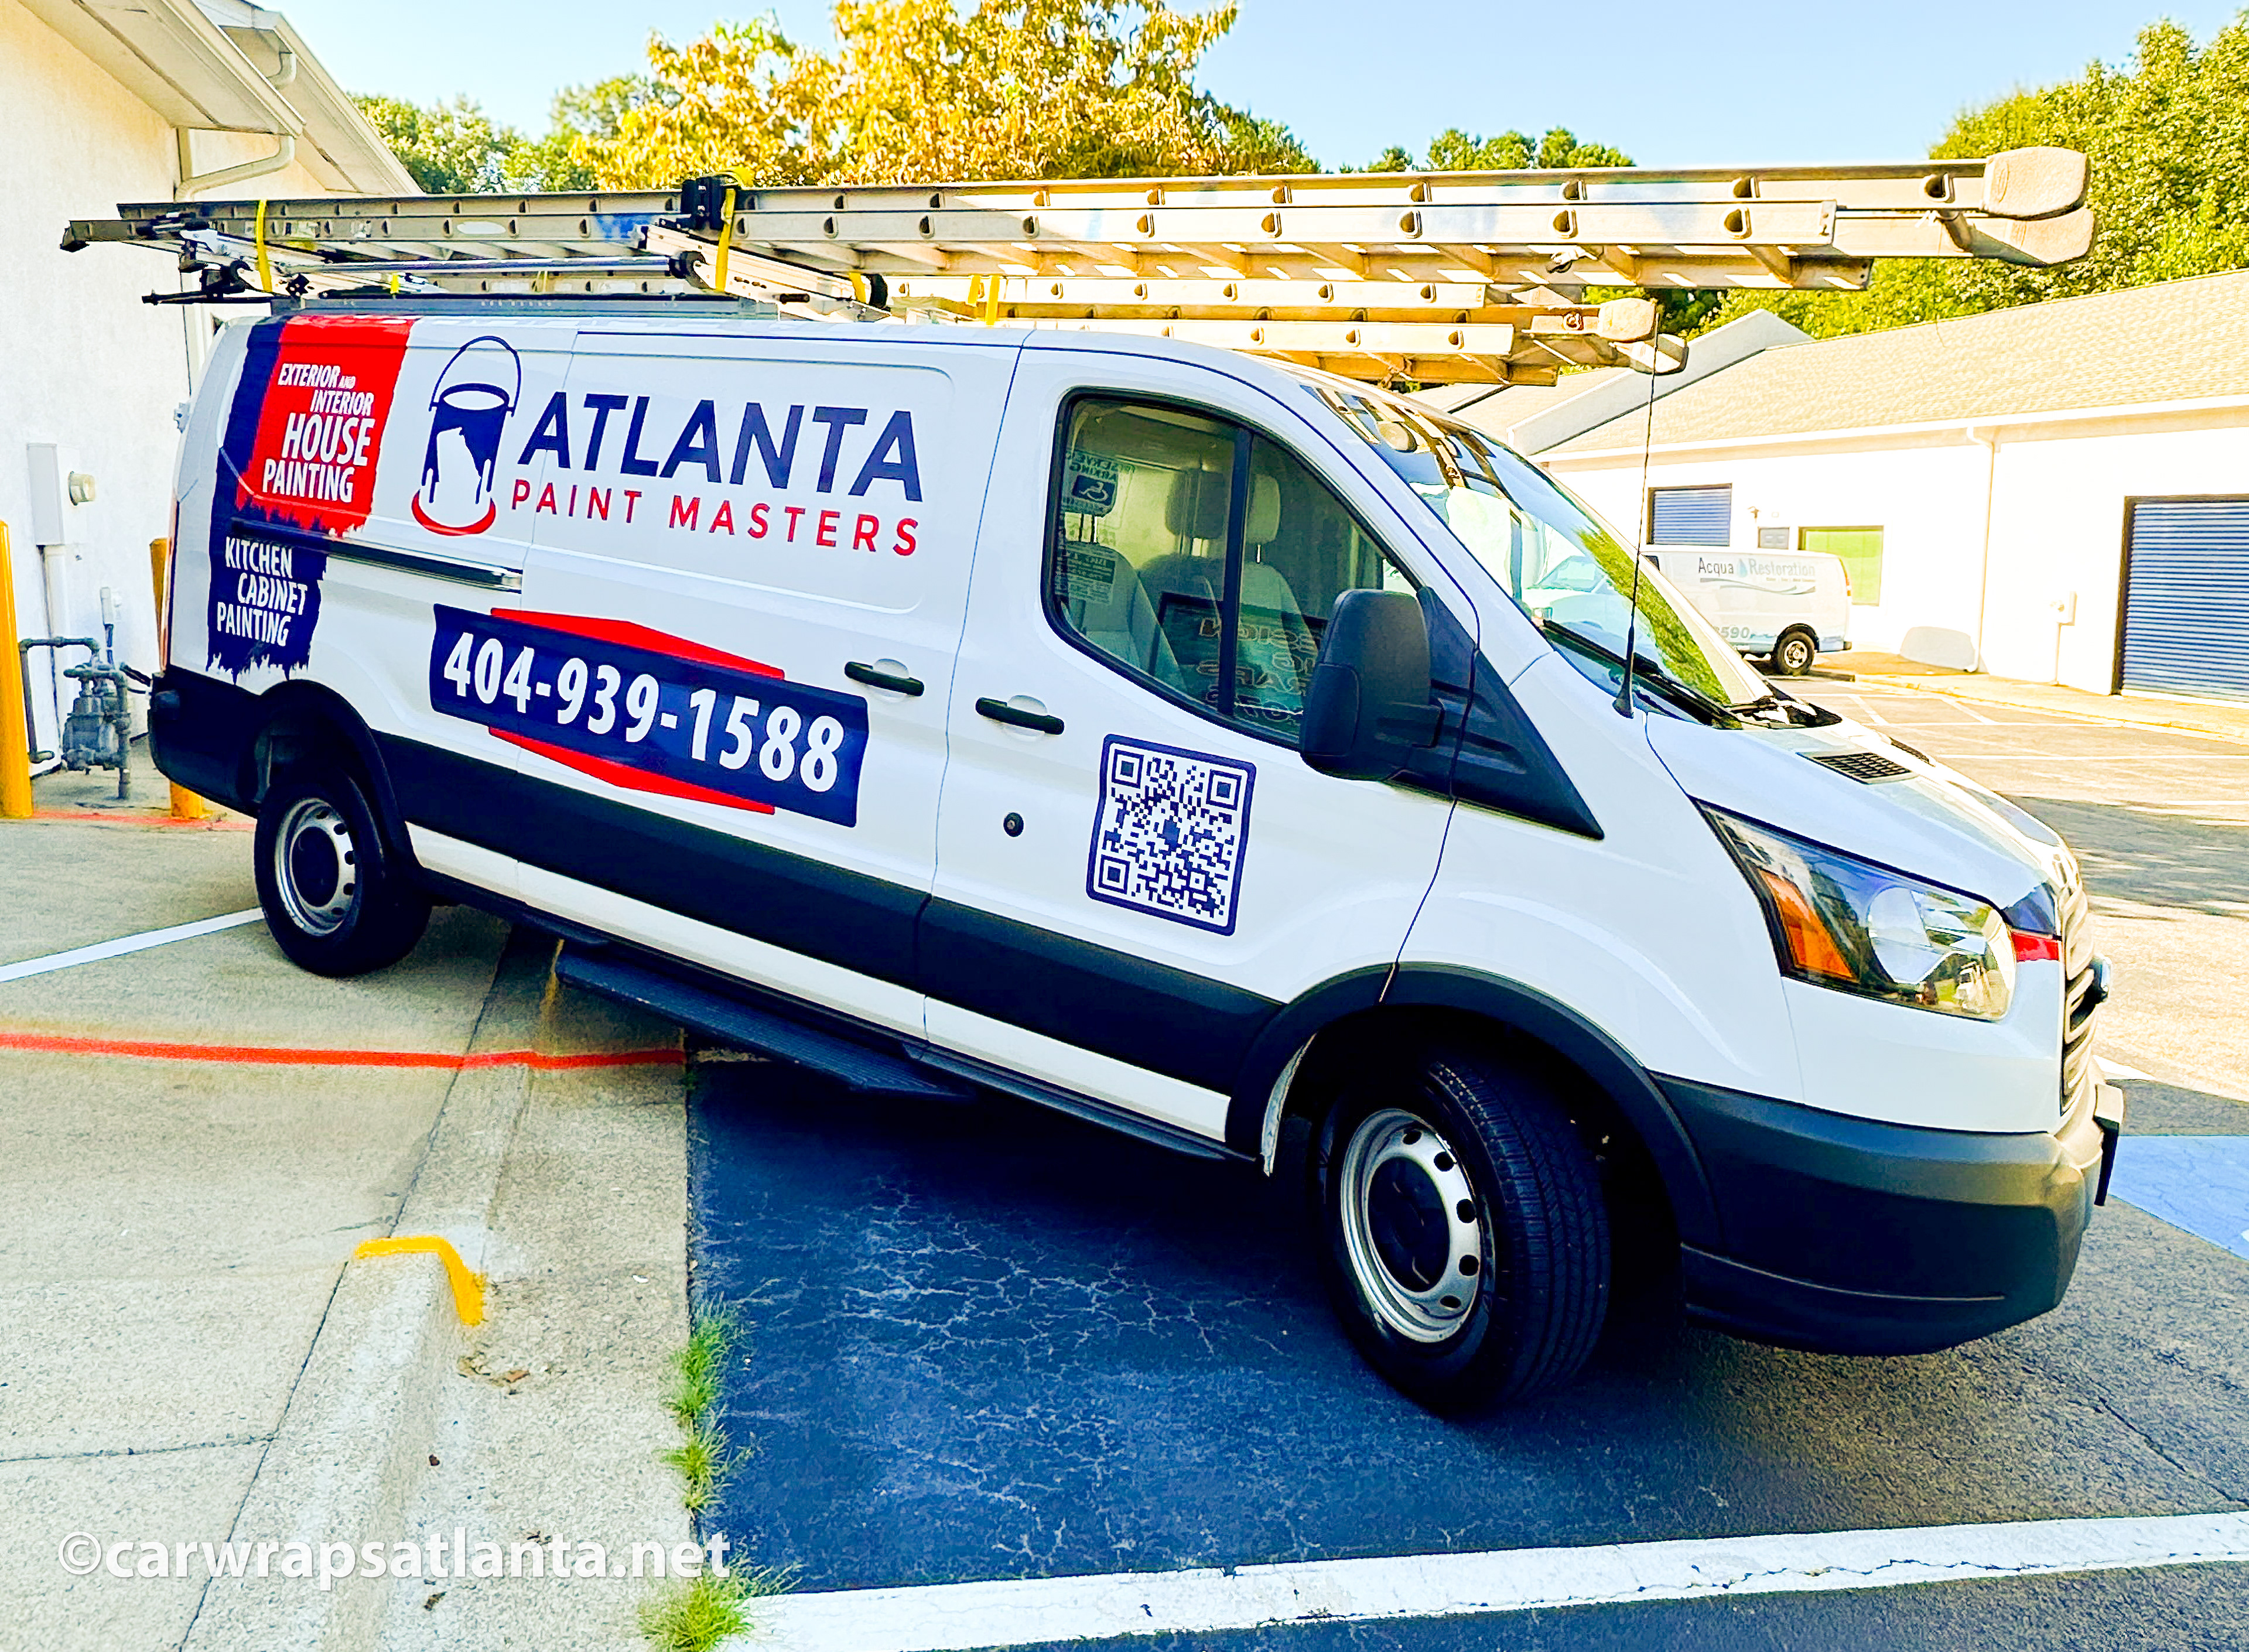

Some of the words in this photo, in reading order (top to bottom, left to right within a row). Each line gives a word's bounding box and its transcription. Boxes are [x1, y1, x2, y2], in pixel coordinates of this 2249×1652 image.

[278, 364, 340, 388] EXTERIOR
[339, 376, 356, 389] AND
[310, 389, 375, 416] INTERIOR
[281, 412, 375, 466] HOUSE
[517, 391, 924, 502] ATLANTA
[263, 459, 355, 503] PAINTING
[511, 479, 642, 524] PAINT
[669, 495, 919, 556] MASTERS
[225, 536, 293, 579] KITCHEN
[1698, 557, 1734, 577] Acqua
[1749, 558, 1815, 576] Restoration
[237, 573, 308, 615] CABINET
[217, 601, 291, 647] PAINTING
[443, 632, 845, 793] 404-939-1588
